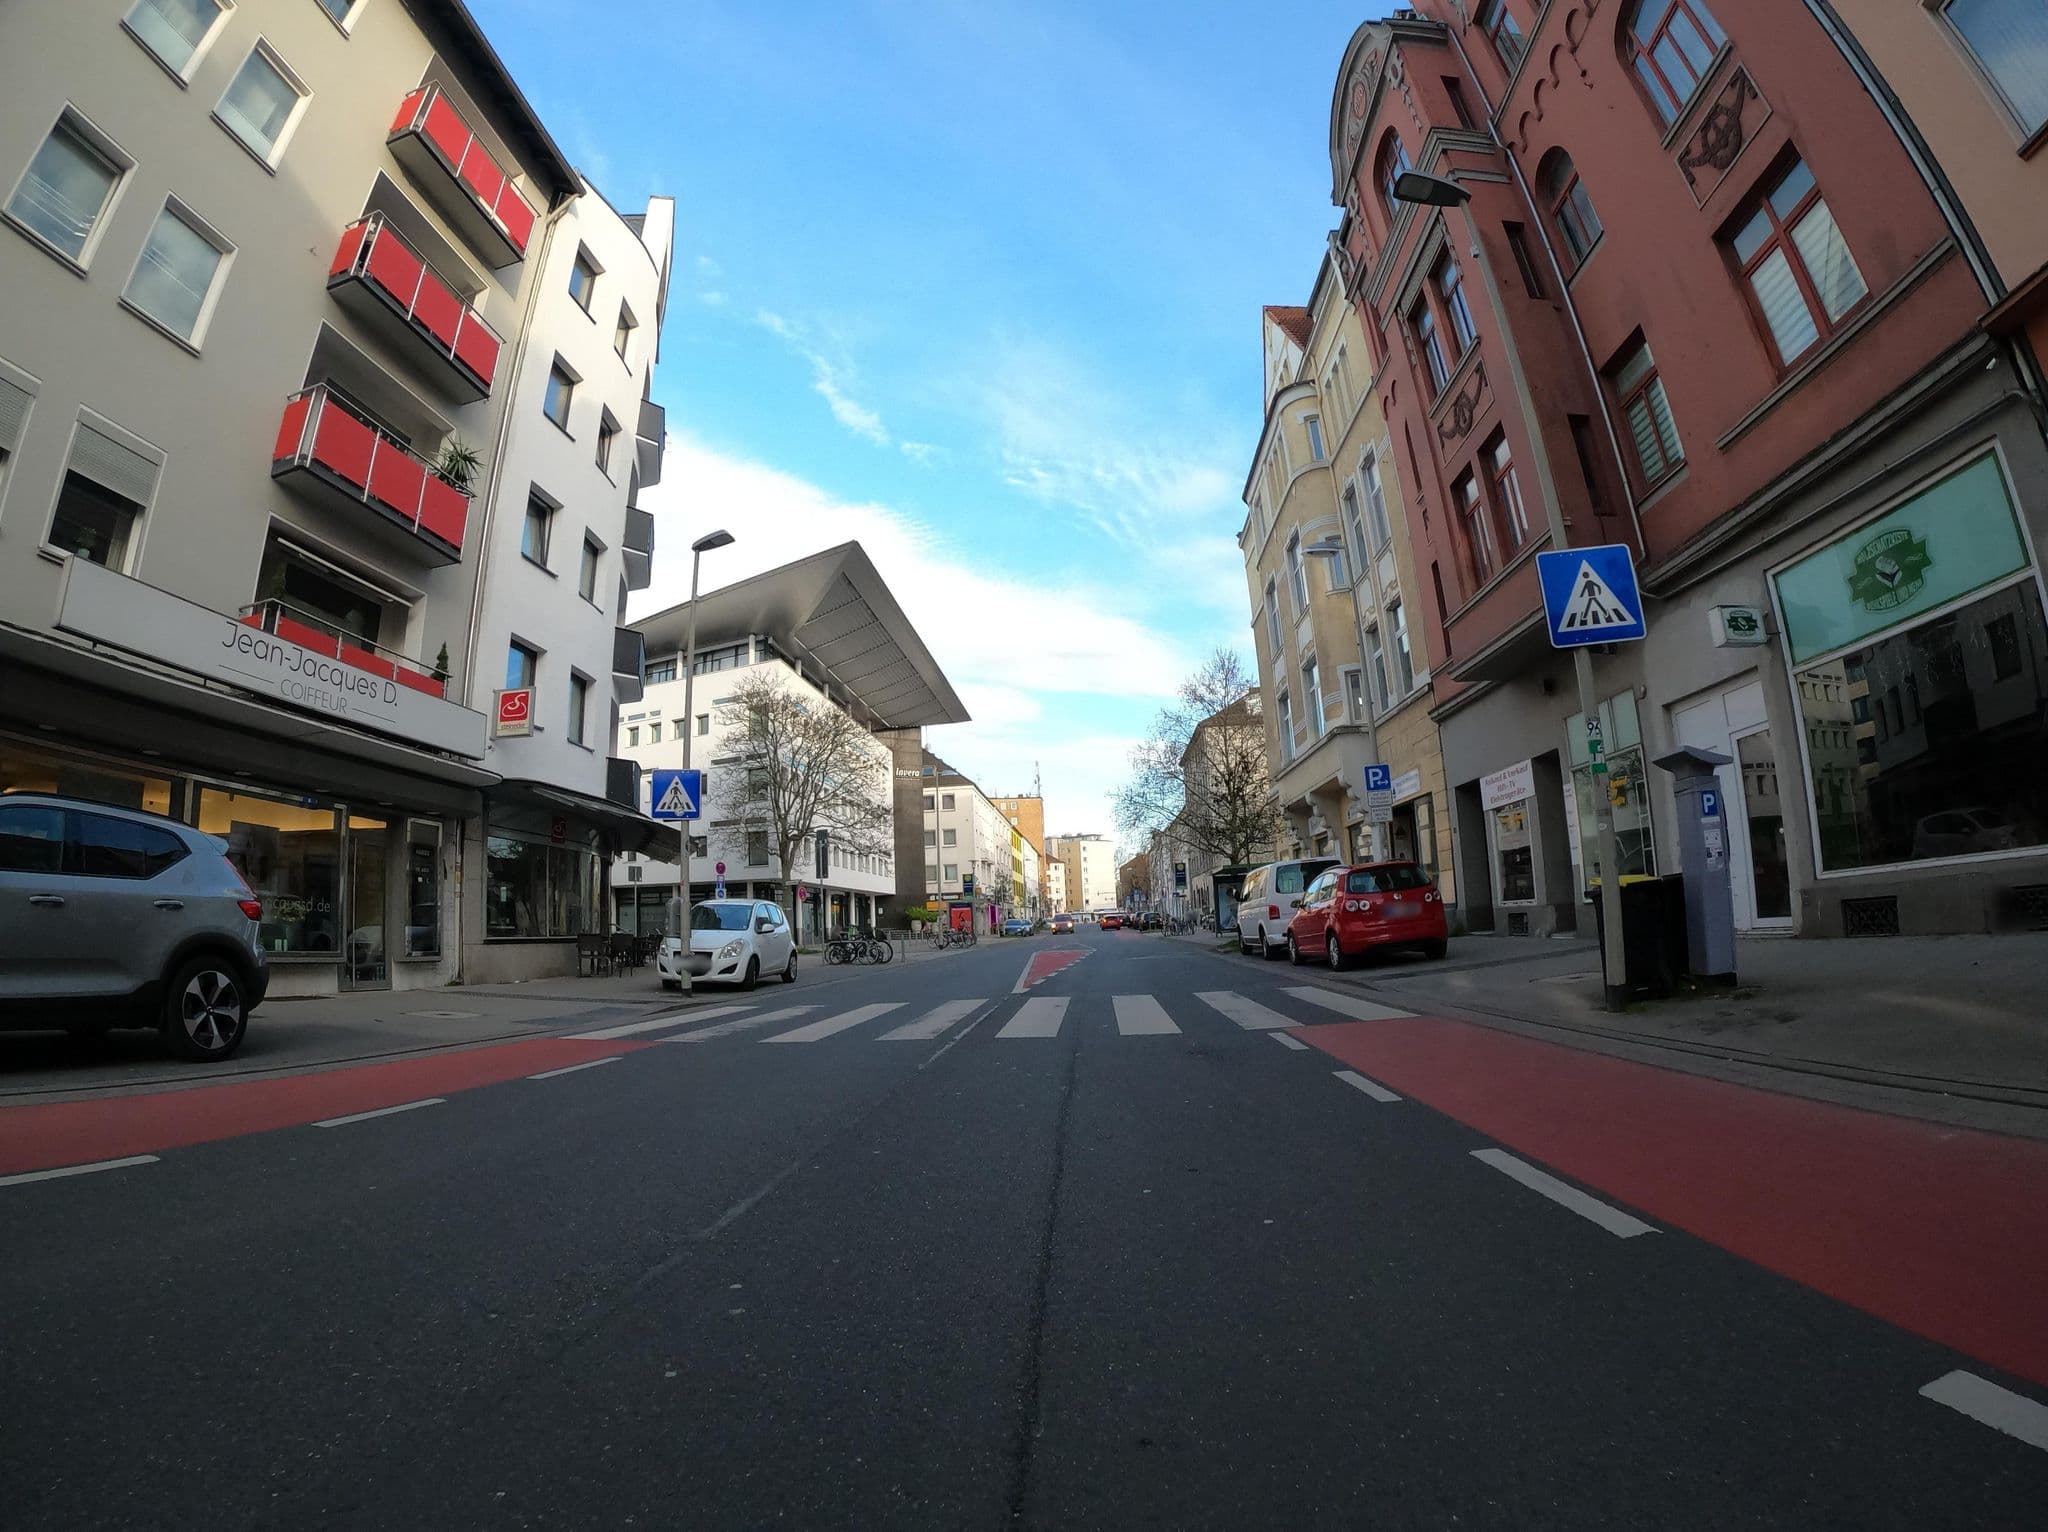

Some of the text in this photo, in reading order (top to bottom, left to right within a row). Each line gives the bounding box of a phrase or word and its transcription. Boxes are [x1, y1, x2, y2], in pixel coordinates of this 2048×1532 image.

[222, 621, 398, 706] Jean-Jacques D.
[281, 678, 347, 713] COIFFEUR
[1368, 768, 1383, 789] P
